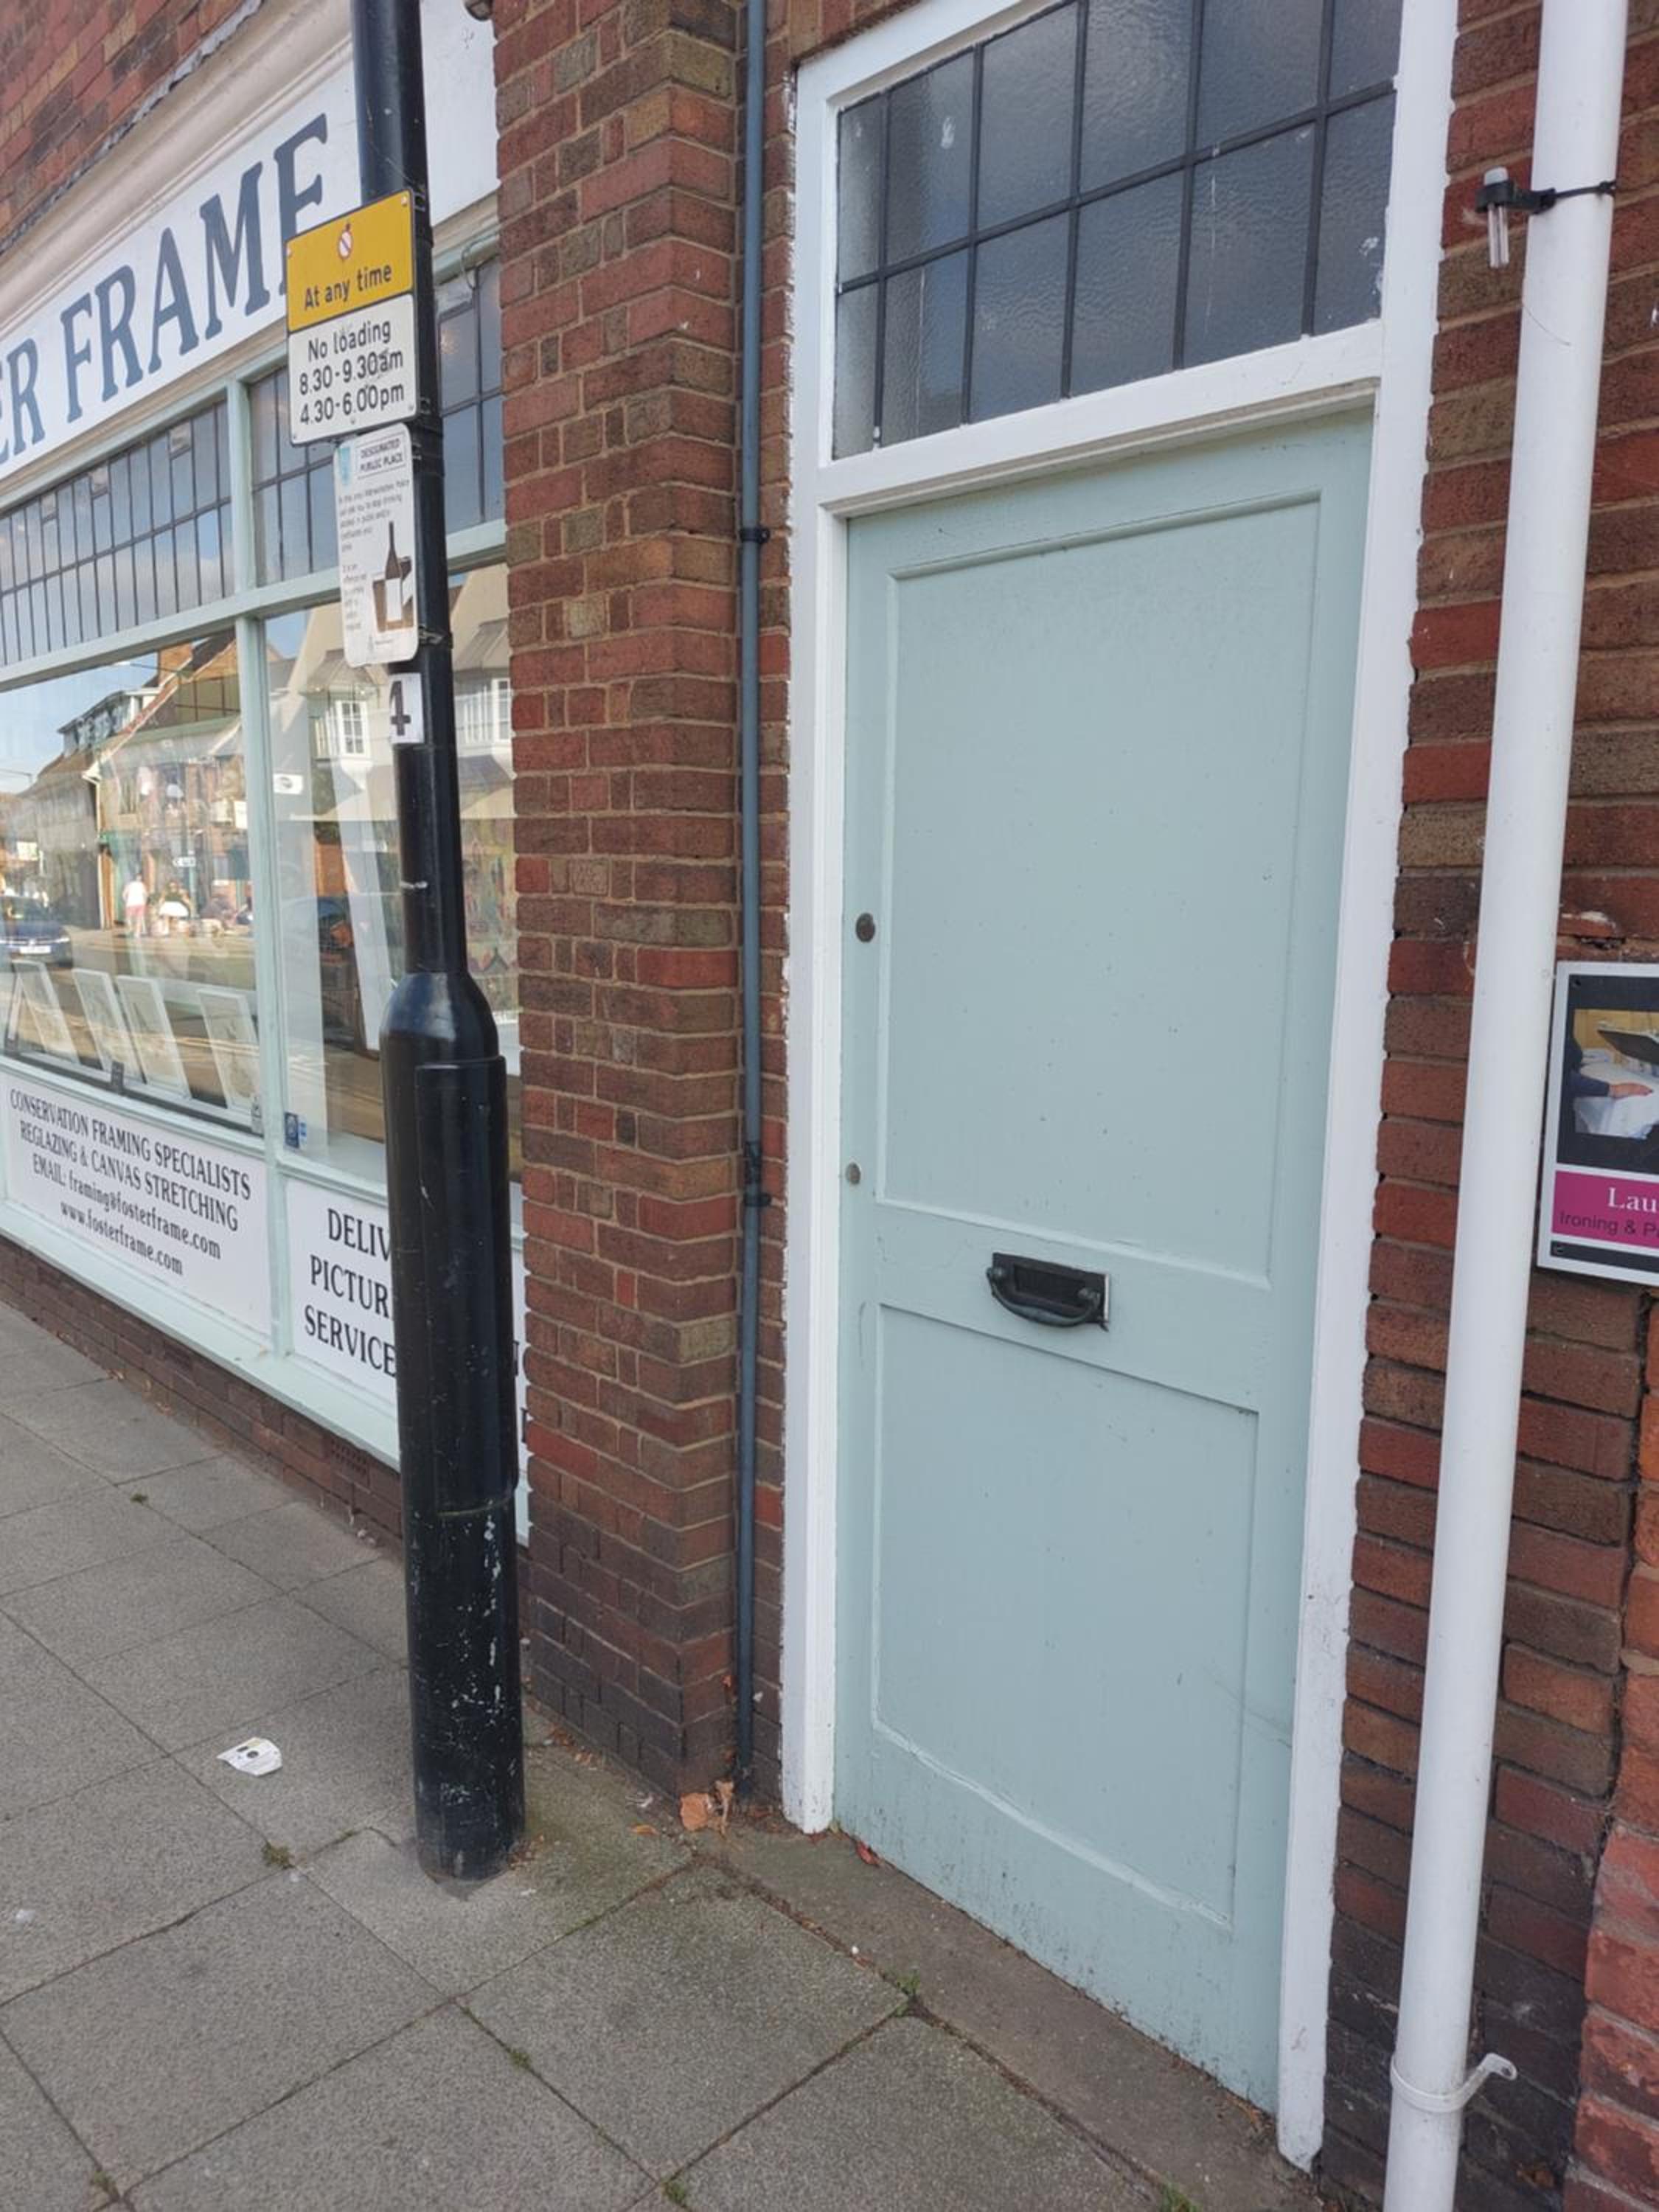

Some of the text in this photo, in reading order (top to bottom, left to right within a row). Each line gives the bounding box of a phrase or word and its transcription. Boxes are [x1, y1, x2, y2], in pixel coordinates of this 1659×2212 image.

[304, 263, 392, 310] At any time
[307, 319, 392, 362] No loading
[0, 338, 45, 465] R
[389, 680, 411, 736] 4
[10, 1088, 251, 1200] CONSERVATION FRAMING SPECIALISTS
[19, 1120, 238, 1232] REGLAZING & CANVAS STRETCHING
[69, 1169, 221, 1260] framing@fosterframe.com
[1559, 1211, 1659, 1238] Ironing & P
[1607, 1186, 1658, 1214] Lau
[60, 1201, 184, 1276] www.fosterframe.com
[304, 1304, 397, 1378] SERVICE
